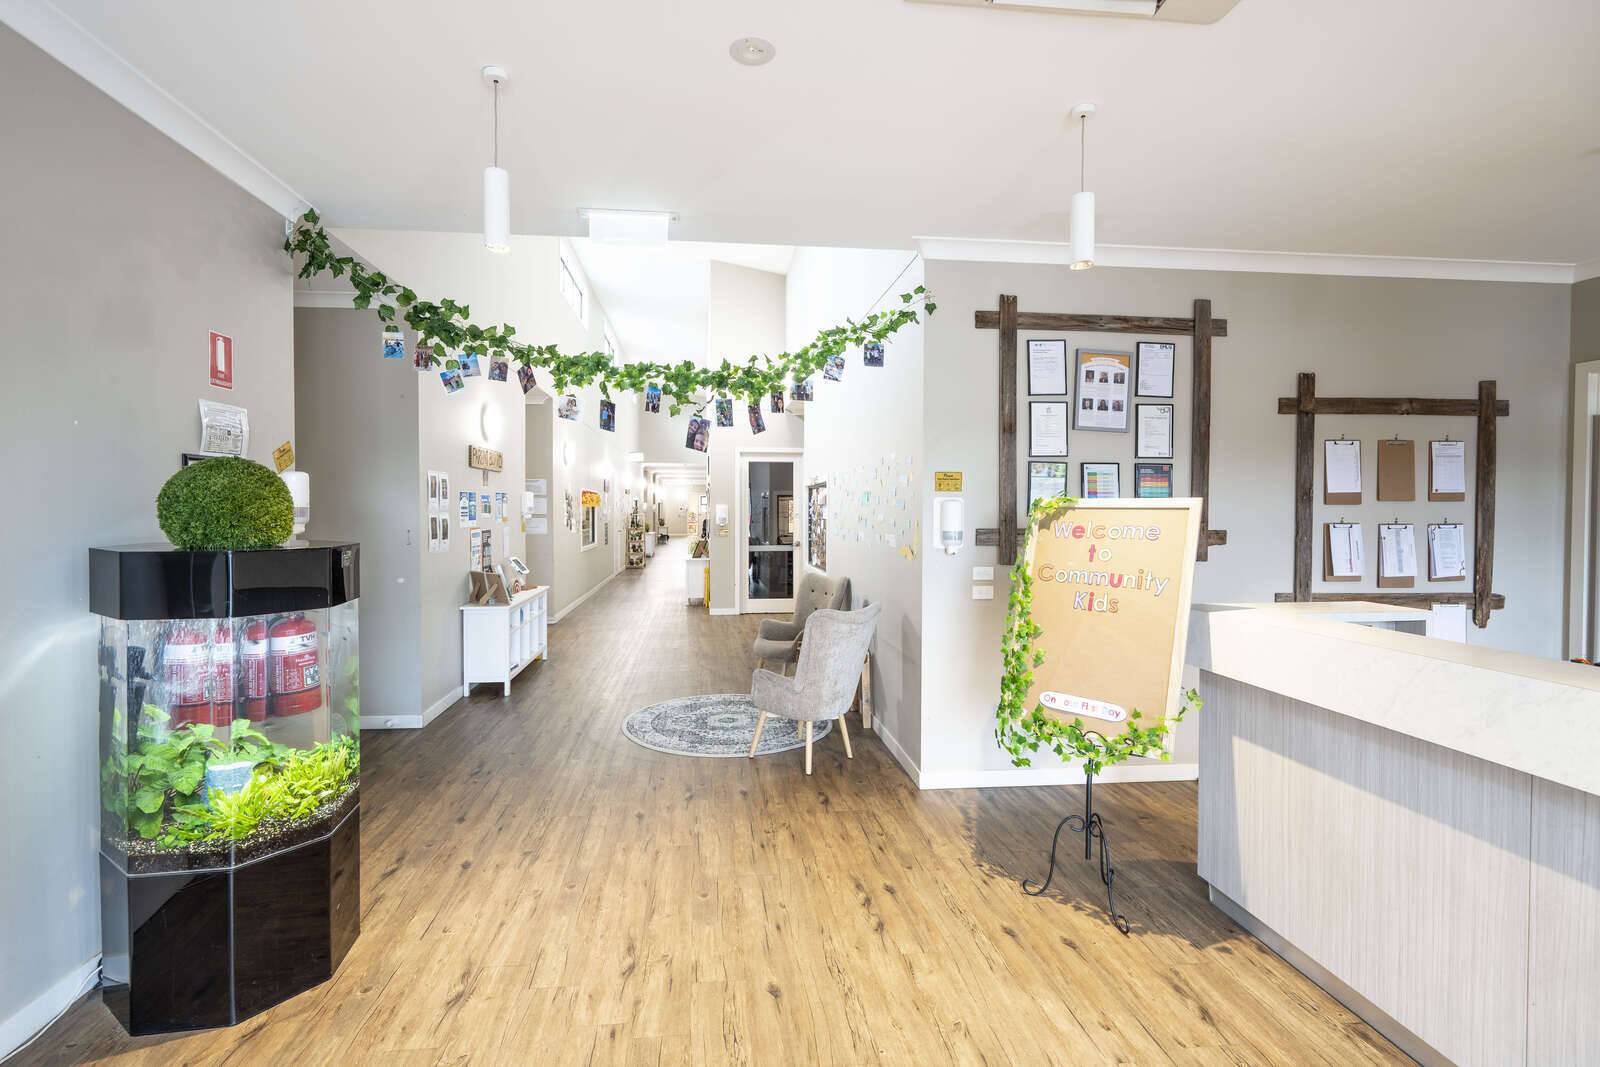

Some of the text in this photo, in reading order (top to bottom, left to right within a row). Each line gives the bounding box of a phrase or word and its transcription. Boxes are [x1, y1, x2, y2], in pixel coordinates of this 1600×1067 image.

[1054, 520, 1161, 541] Welcome
[1089, 544, 1112, 562] to
[1038, 563, 1170, 597] Community
[1073, 591, 1119, 614] Kids
